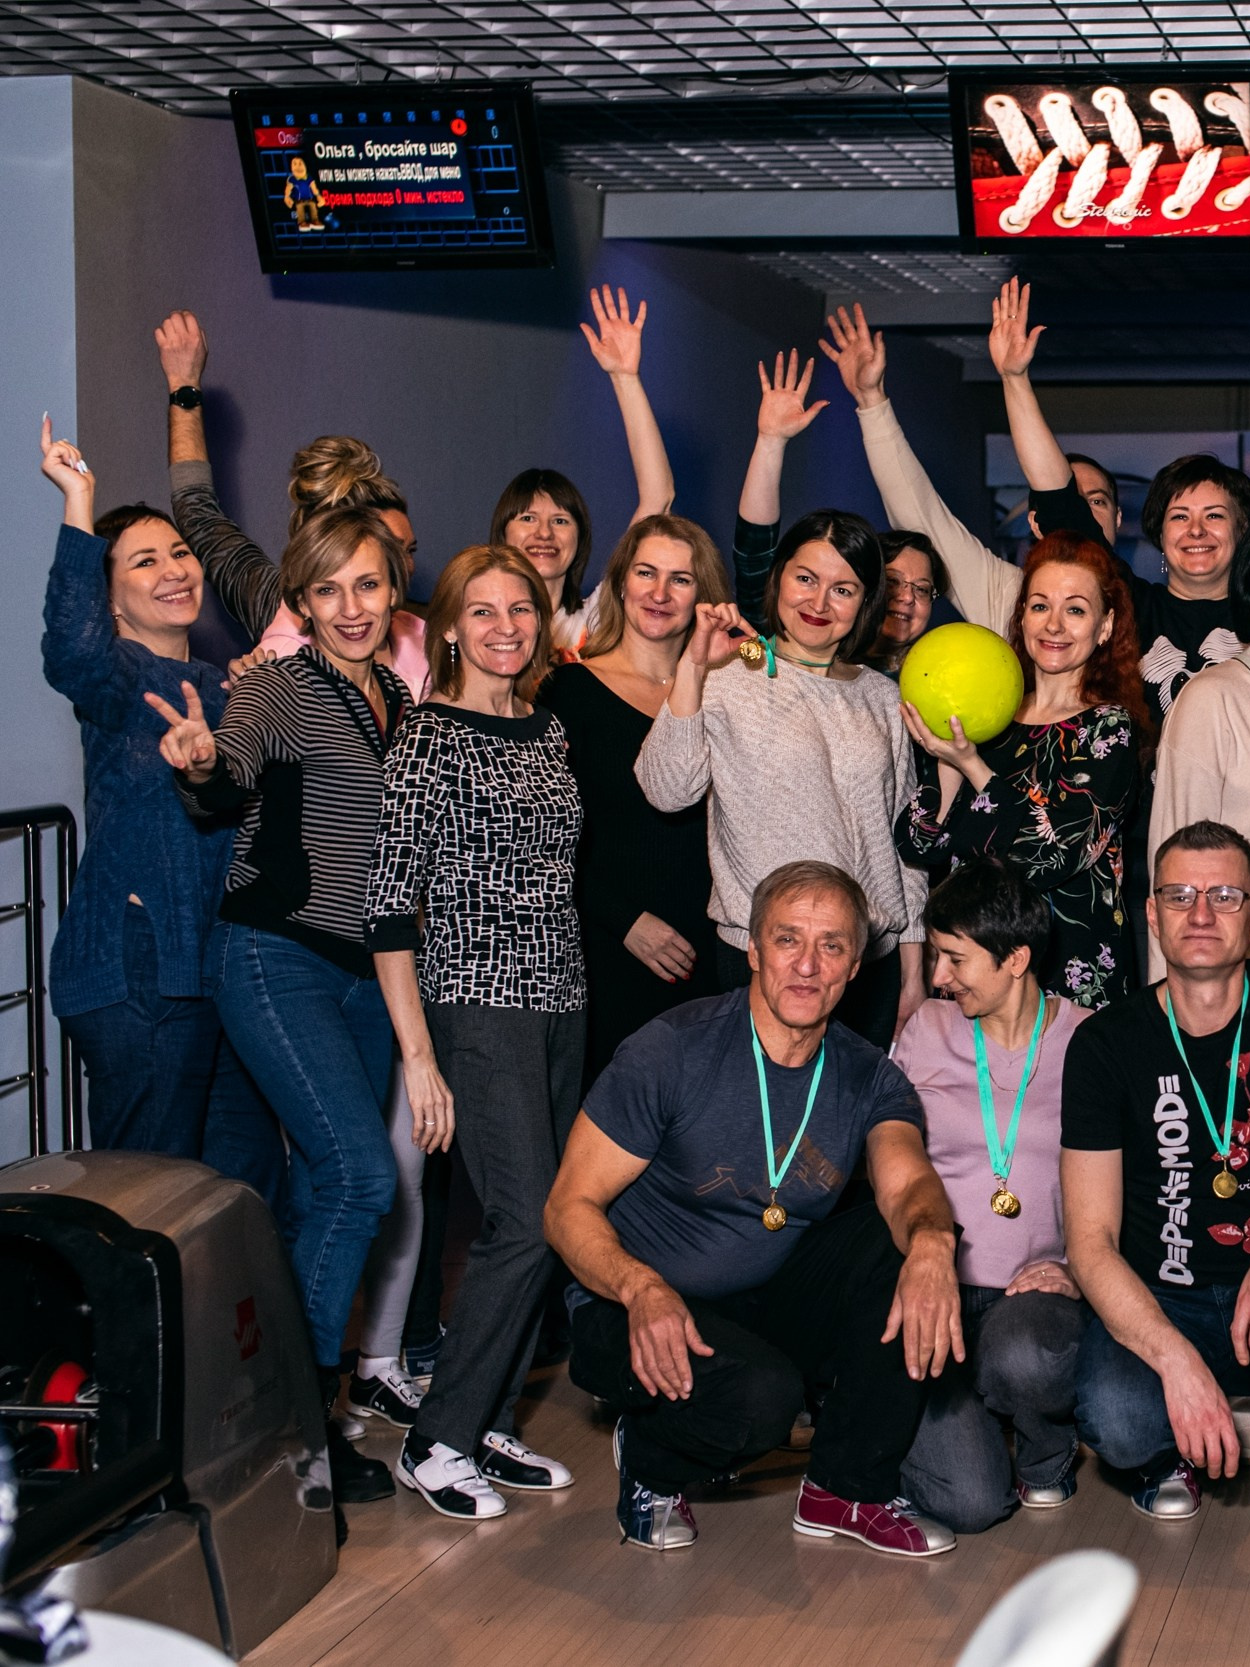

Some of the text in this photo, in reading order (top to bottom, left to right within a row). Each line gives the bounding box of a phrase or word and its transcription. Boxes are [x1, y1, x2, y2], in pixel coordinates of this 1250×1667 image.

[314, 141, 356, 159] Ольга
[364, 139, 427, 161] бросайте
[429, 141, 457, 159] шар
[318, 169, 333, 182] или
[334, 168, 346, 182] вы
[347, 168, 375, 181] можете
[439, 166, 461, 179] меню
[321, 189, 353, 209] Время
[354, 191, 395, 208] подхода
[403, 191, 425, 205] мин.
[426, 190, 465, 204] истекло
[1153, 1074, 1194, 1168] MODE
